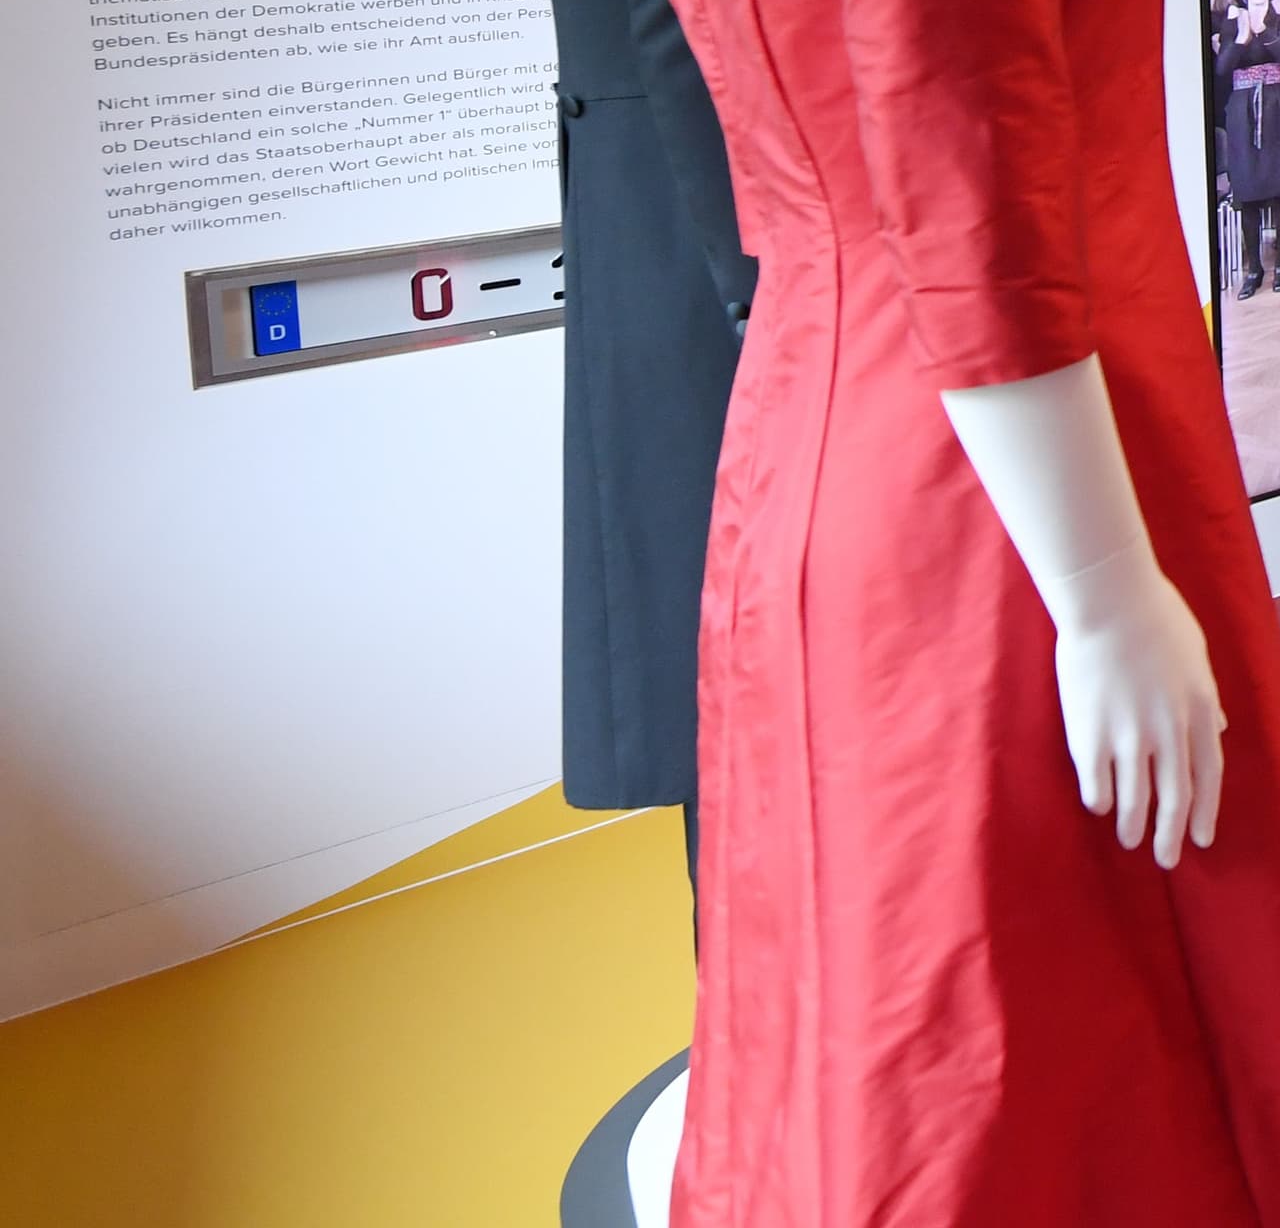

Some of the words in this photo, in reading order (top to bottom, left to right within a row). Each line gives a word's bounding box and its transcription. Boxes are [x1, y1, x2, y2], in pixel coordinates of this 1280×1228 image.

[90, 10, 209, 27] Institutionen
[215, 7, 246, 20] der
[252, 0, 356, 17] Demokratie
[167, 31, 189, 44] Es
[194, 28, 248, 42] hängt
[254, 22, 325, 38] deshalb
[330, 14, 446, 32] entscheidend
[451, 14, 481, 24] von
[486, 11, 513, 22] der
[518, 8, 552, 20] Pers
[94, 48, 280, 70] Bundespräsidenten
[317, 42, 348, 54] wie
[353, 39, 378, 52] sie
[383, 38, 404, 49] ihr
[410, 35, 444, 47] Amt
[98, 96, 150, 111] Nicht
[156, 92, 216, 106] immer
[222, 86, 260, 100] sind
[267, 84, 295, 96] die
[301, 76, 410, 94] Bürgerinnen
[416, 70, 448, 84] und
[453, 68, 508, 80] Bürger
[514, 63, 538, 74] mit
[99, 120, 144, 132] ihrer
[150, 109, 262, 128] Präsidenten
[403, 85, 506, 104] Gelegentlich
[511, 81, 544, 94] wird
[101, 141, 127, 154] ob
[133, 128, 252, 152] Deutschland
[258, 126, 285, 139] ein
[290, 121, 348, 136] solche
[458, 102, 540, 119] überhaupt
[103, 161, 162, 176] vielen
[168, 154, 210, 169] wird
[216, 152, 250, 164] das
[256, 135, 404, 160] Staatsoberhaupt
[409, 132, 446, 144] aber
[452, 128, 475, 140] als
[480, 119, 557, 136] moralisch
[272, 165, 324, 179] deren
[328, 158, 370, 172] Wort
[375, 151, 444, 168] Gewicht
[483, 143, 528, 156] Seine
[107, 195, 242, 219] unabhängigen
[248, 176, 402, 206] gesellschaftlichen
[407, 170, 438, 184] und
[443, 162, 527, 182] politischen
[109, 225, 166, 241] daher
[269, 324, 286, 341] D
